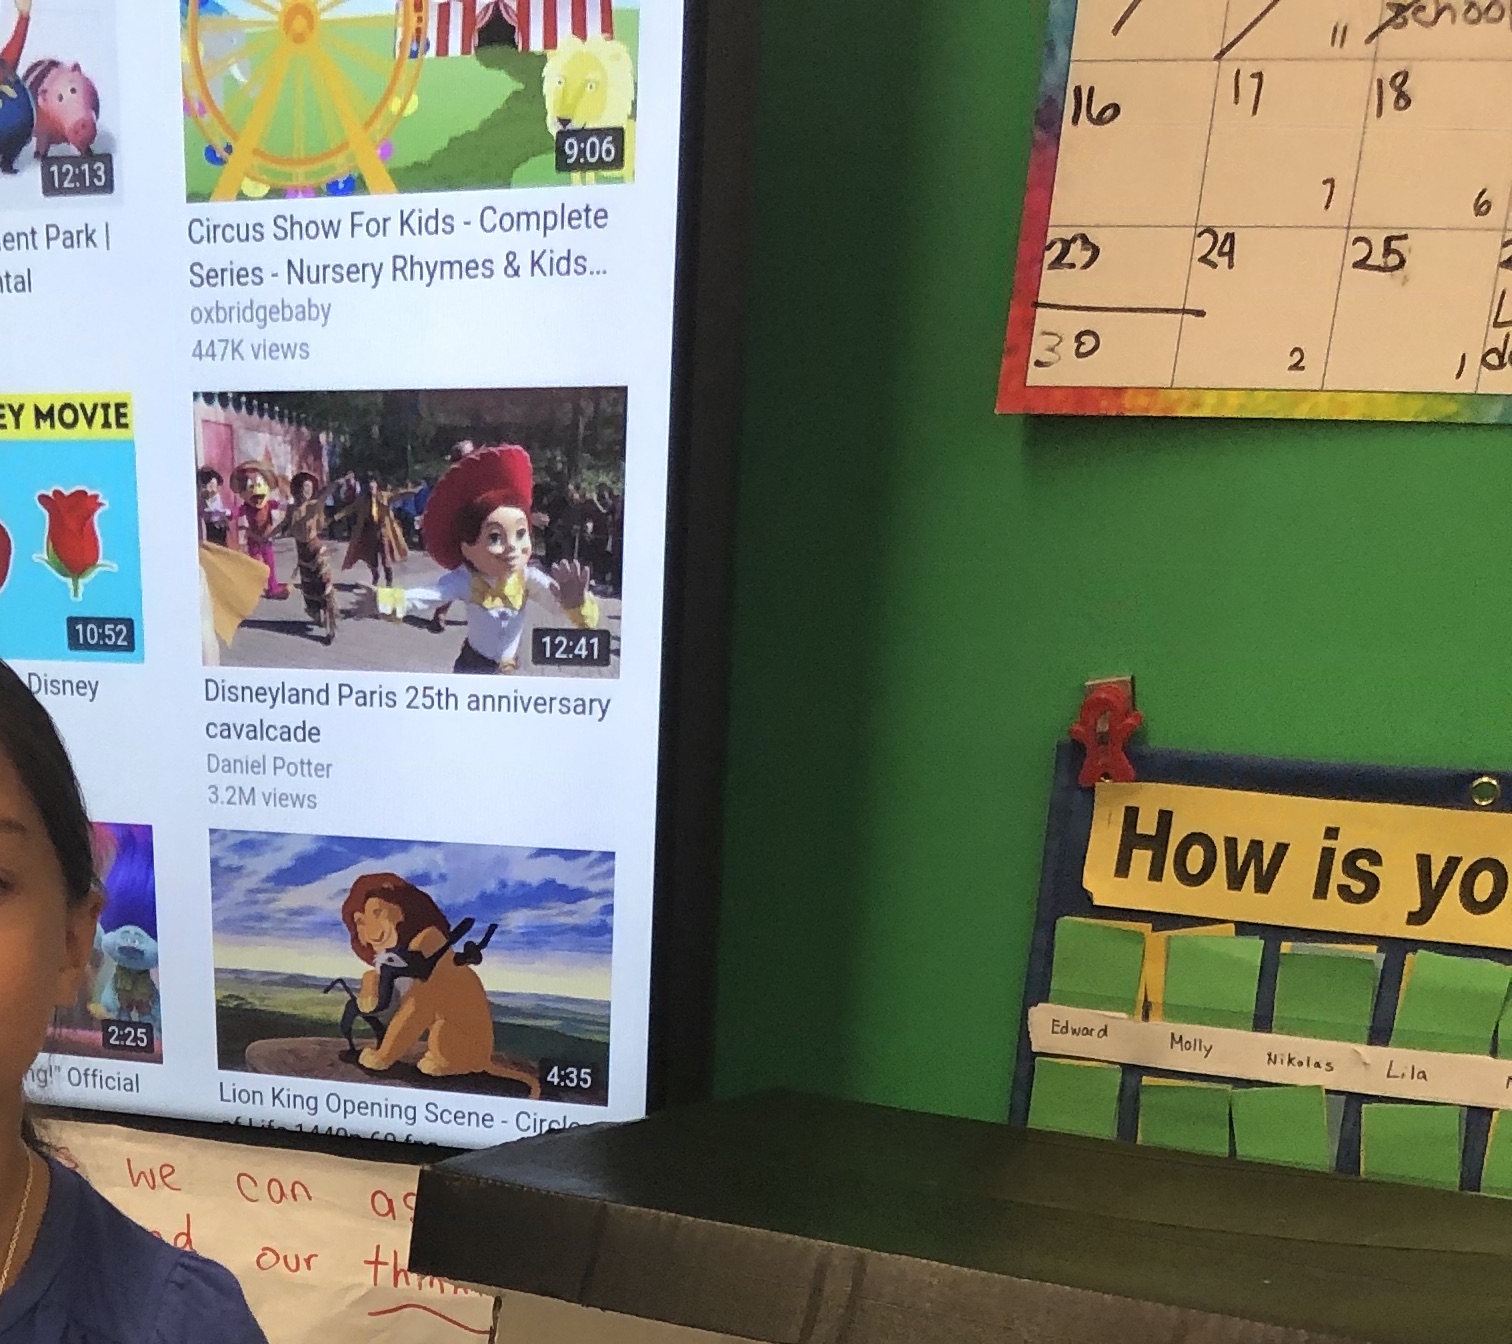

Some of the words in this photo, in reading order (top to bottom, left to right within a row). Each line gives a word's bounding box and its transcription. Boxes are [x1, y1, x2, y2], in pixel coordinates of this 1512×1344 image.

[1071, 86, 1122, 127] 16
[1232, 68, 1265, 117] 17
[1375, 69, 1413, 118] 18
[563, 135, 616, 165] 9:06
[49, 162, 107, 189] 12:13
[1473, 186, 1493, 218] 6
[45, 222, 99, 251] Park
[187, 216, 265, 245] Circus
[272, 212, 343, 243] Show
[349, 210, 392, 239] For
[398, 206, 456, 236] Kids
[479, 202, 609, 238] Complete
[1044, 232, 1102, 272] 23
[1196, 227, 1237, 271] 24
[1351, 233, 1410, 274] 25
[188, 260, 265, 289] Series
[286, 256, 384, 289] Nursery
[391, 252, 495, 287] Rhymes
[503, 251, 521, 279] &
[189, 297, 333, 330] oxbridgebaby
[191, 338, 246, 362] 447K
[250, 338, 311, 361] views
[1033, 329, 1102, 368] 30
[1288, 346, 1306, 373] 2
[33, 400, 130, 430] MOVIE
[74, 623, 128, 647] 10:52
[540, 634, 601, 661] 12:41
[27, 672, 100, 702] Disney
[204, 678, 330, 710] Disneyland
[337, 682, 398, 710] Paris
[404, 685, 460, 712] 25th
[466, 689, 611, 722] anniversary
[204, 718, 322, 744] cavalcade
[206, 753, 267, 776] Daniel
[272, 756, 334, 780] Potter
[207, 784, 257, 808] 3.2M
[261, 787, 319, 811] views
[1114, 805, 1290, 895] How
[1312, 826, 1383, 905] is
[1406, 852, 1509, 927] yo
[107, 1025, 148, 1047] 2:25
[1050, 1019, 1109, 1039] Edward
[1170, 1032, 1214, 1060] Molly
[1266, 1051, 1335, 1073] Nikolas
[1386, 1059, 1429, 1083] Lila
[67, 1066, 141, 1094] Official
[545, 1066, 592, 1089] 4:35
[218, 1081, 265, 1107] Lion
[270, 1086, 319, 1116] King
[325, 1091, 418, 1125] Opening
[424, 1102, 495, 1129] Scene
[126, 1157, 183, 1192] we
[236, 1171, 313, 1206] can
[255, 1245, 320, 1274] our
